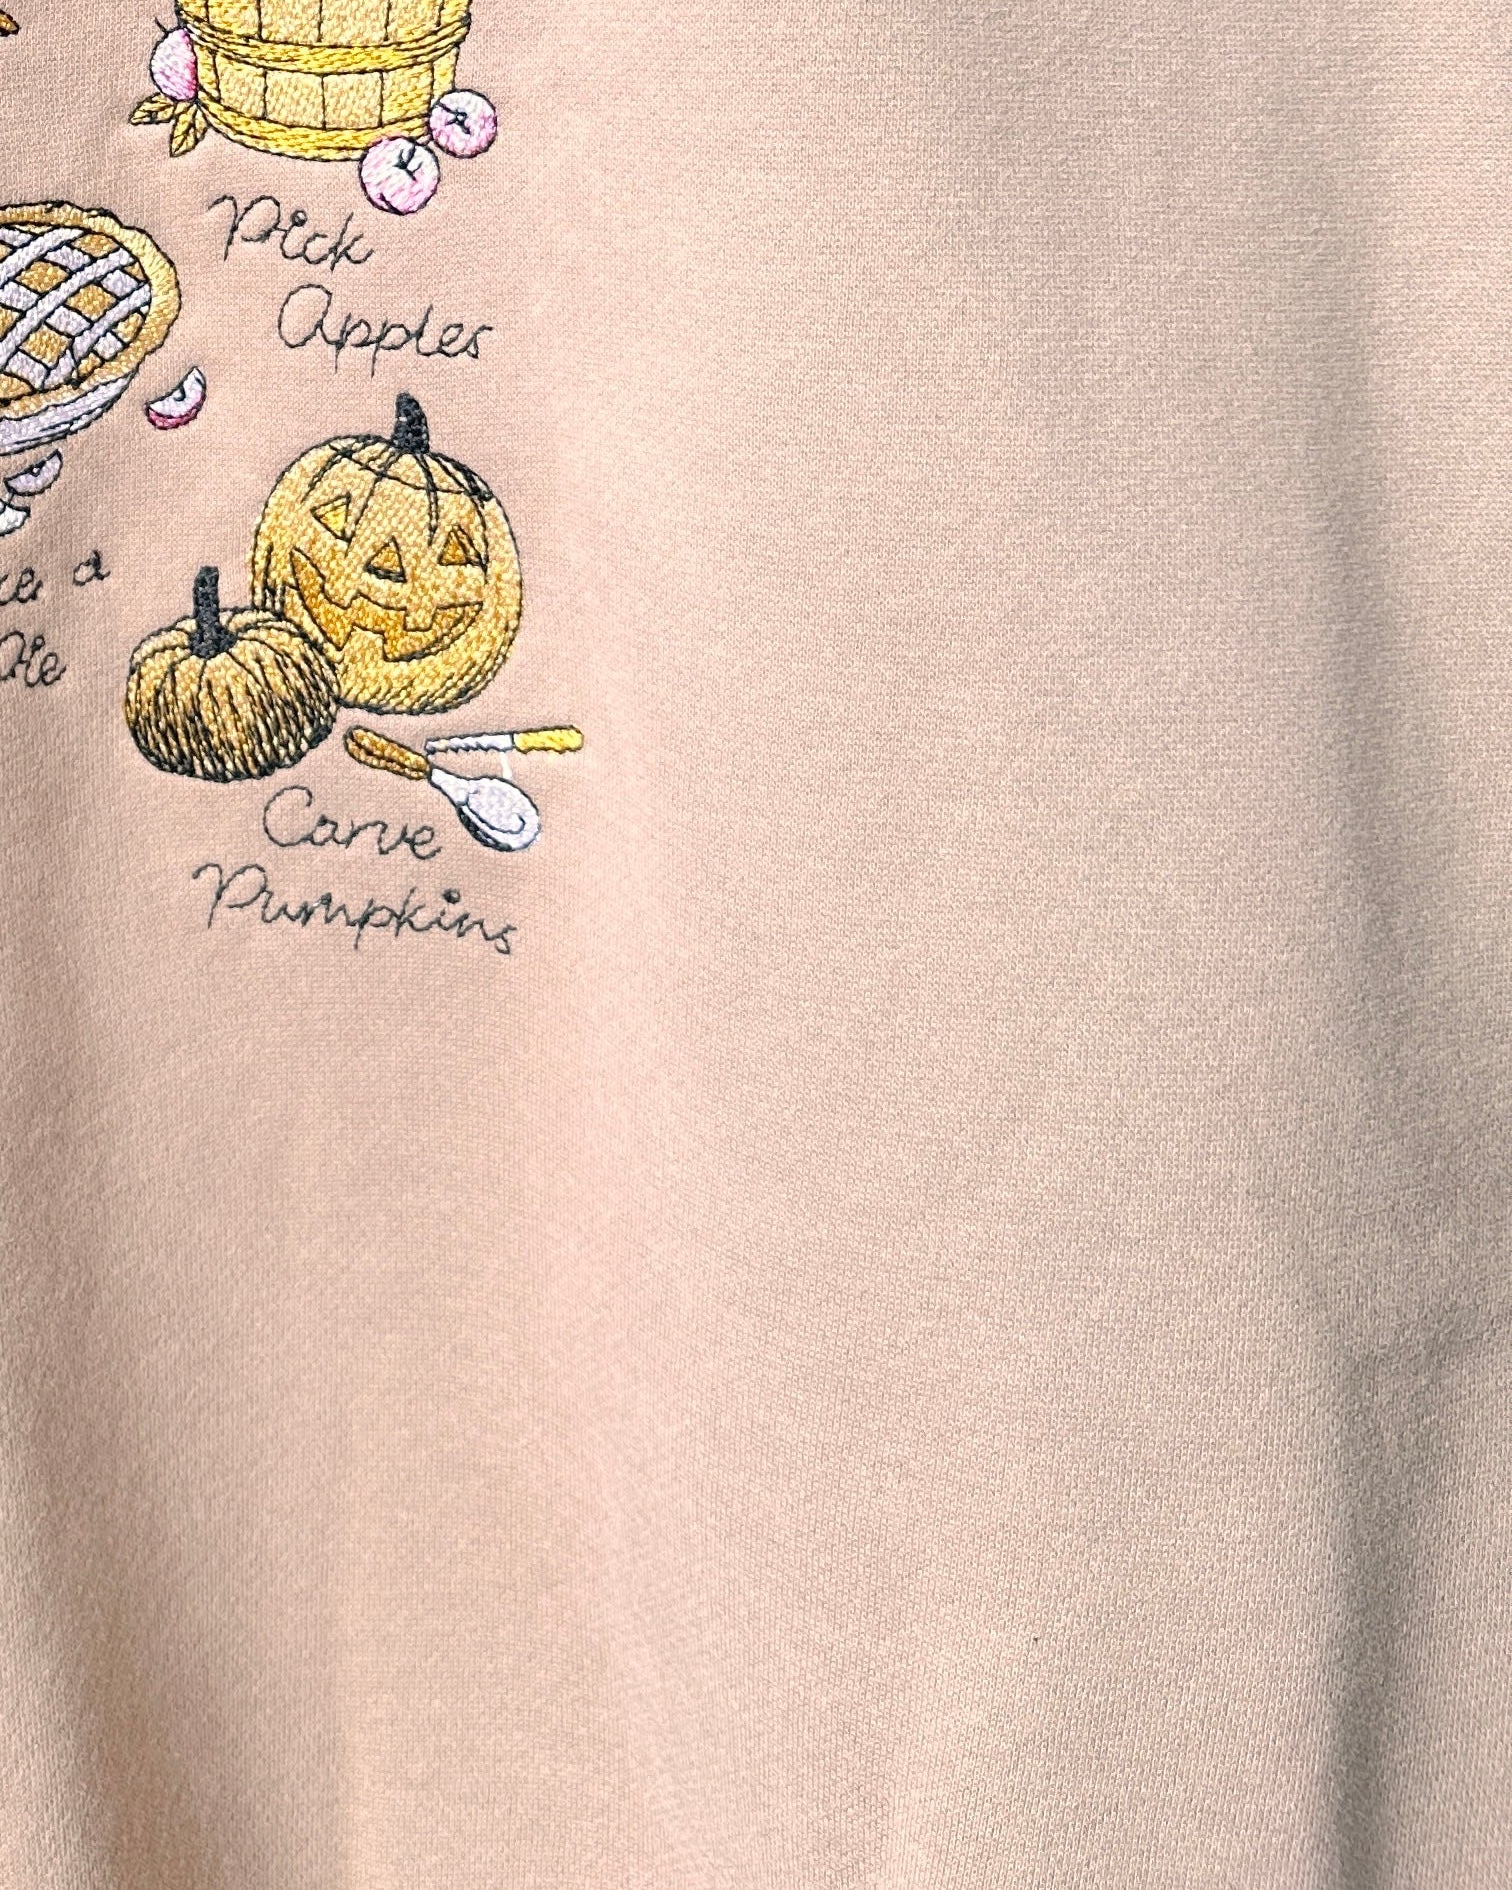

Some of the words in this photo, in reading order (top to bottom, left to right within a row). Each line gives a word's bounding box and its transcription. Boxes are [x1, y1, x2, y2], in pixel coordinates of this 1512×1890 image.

[207, 194, 374, 272] Pick
[277, 283, 493, 379] Apples
[72, 548, 111, 587] a
[262, 784, 442, 860] Carve
[191, 862, 517, 956] Pumpkins
